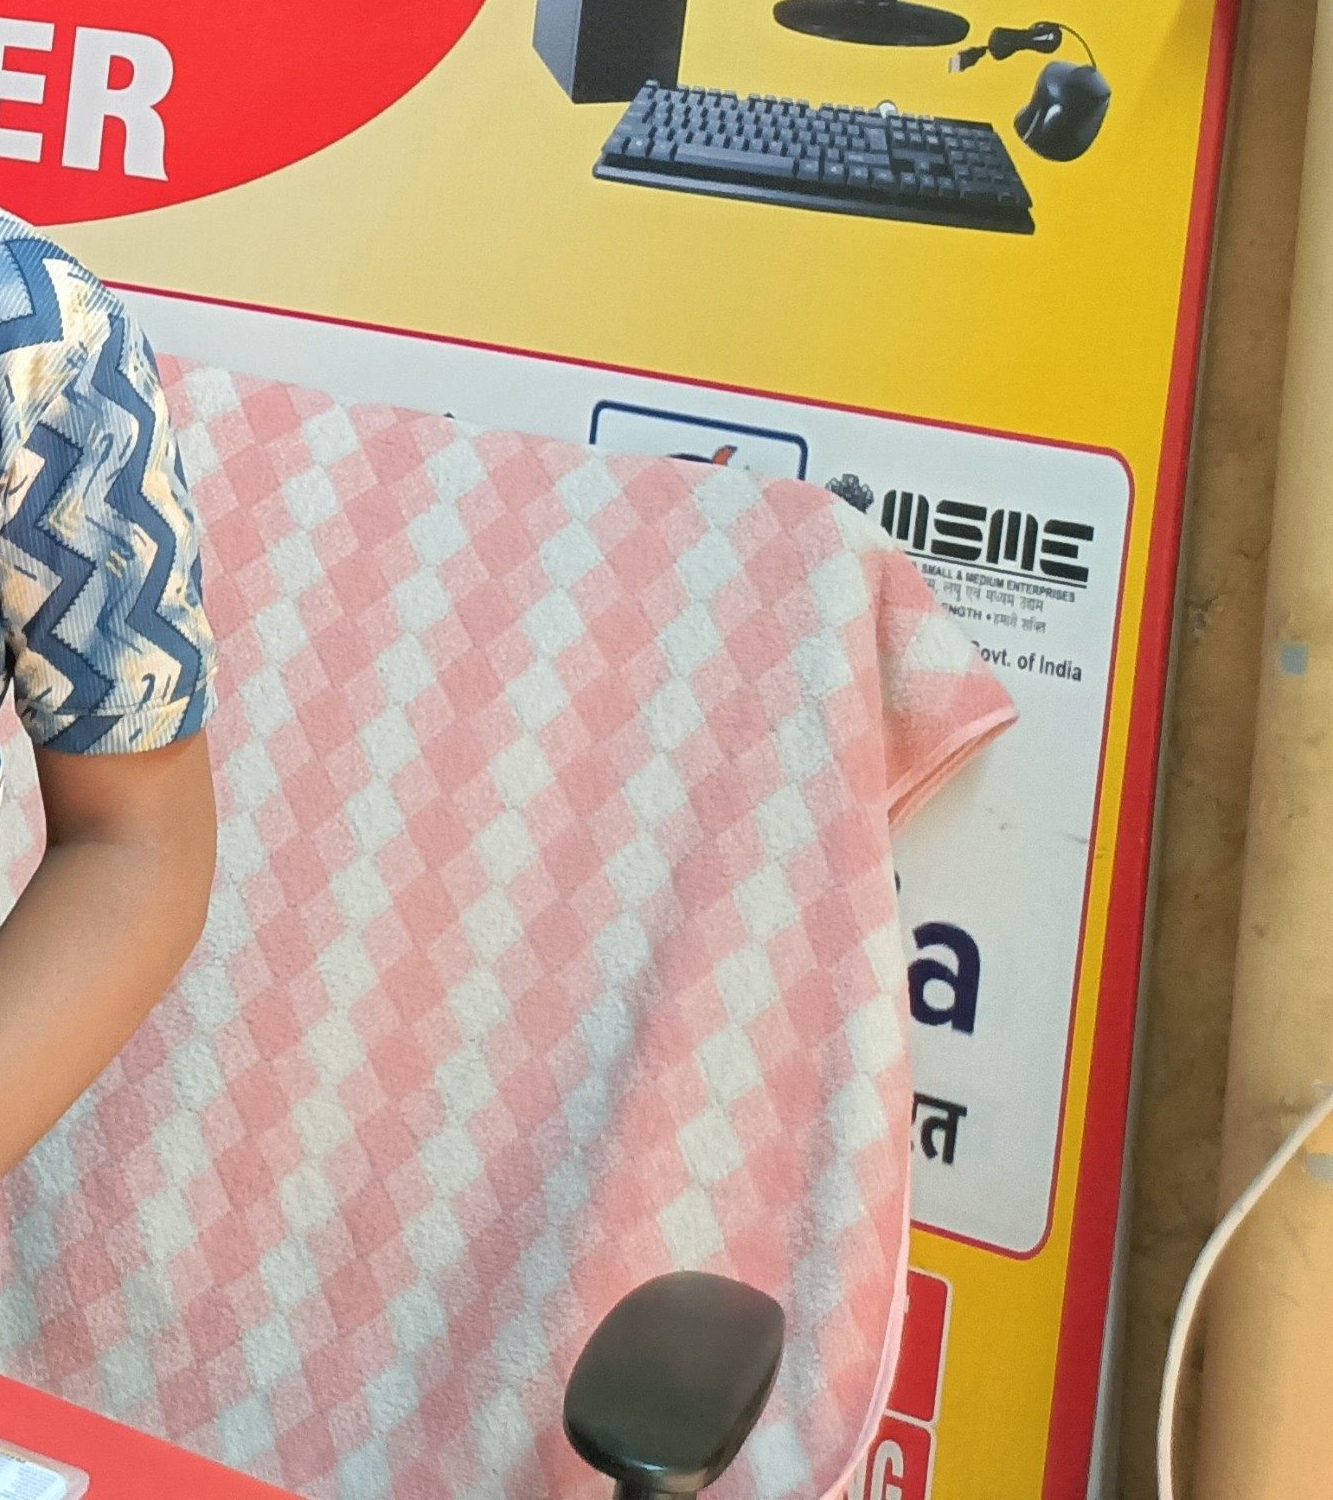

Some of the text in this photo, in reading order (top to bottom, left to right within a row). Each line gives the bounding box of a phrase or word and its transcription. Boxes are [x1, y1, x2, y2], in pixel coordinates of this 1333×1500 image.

[881, 489, 1094, 583] MSME
[921, 564, 953, 580] SMALL
[966, 572, 1004, 588] MEDIUM
[1007, 582, 1075, 602] ENTERPRISES
[1017, 653, 1035, 671] of
[1040, 655, 1082, 681] India
